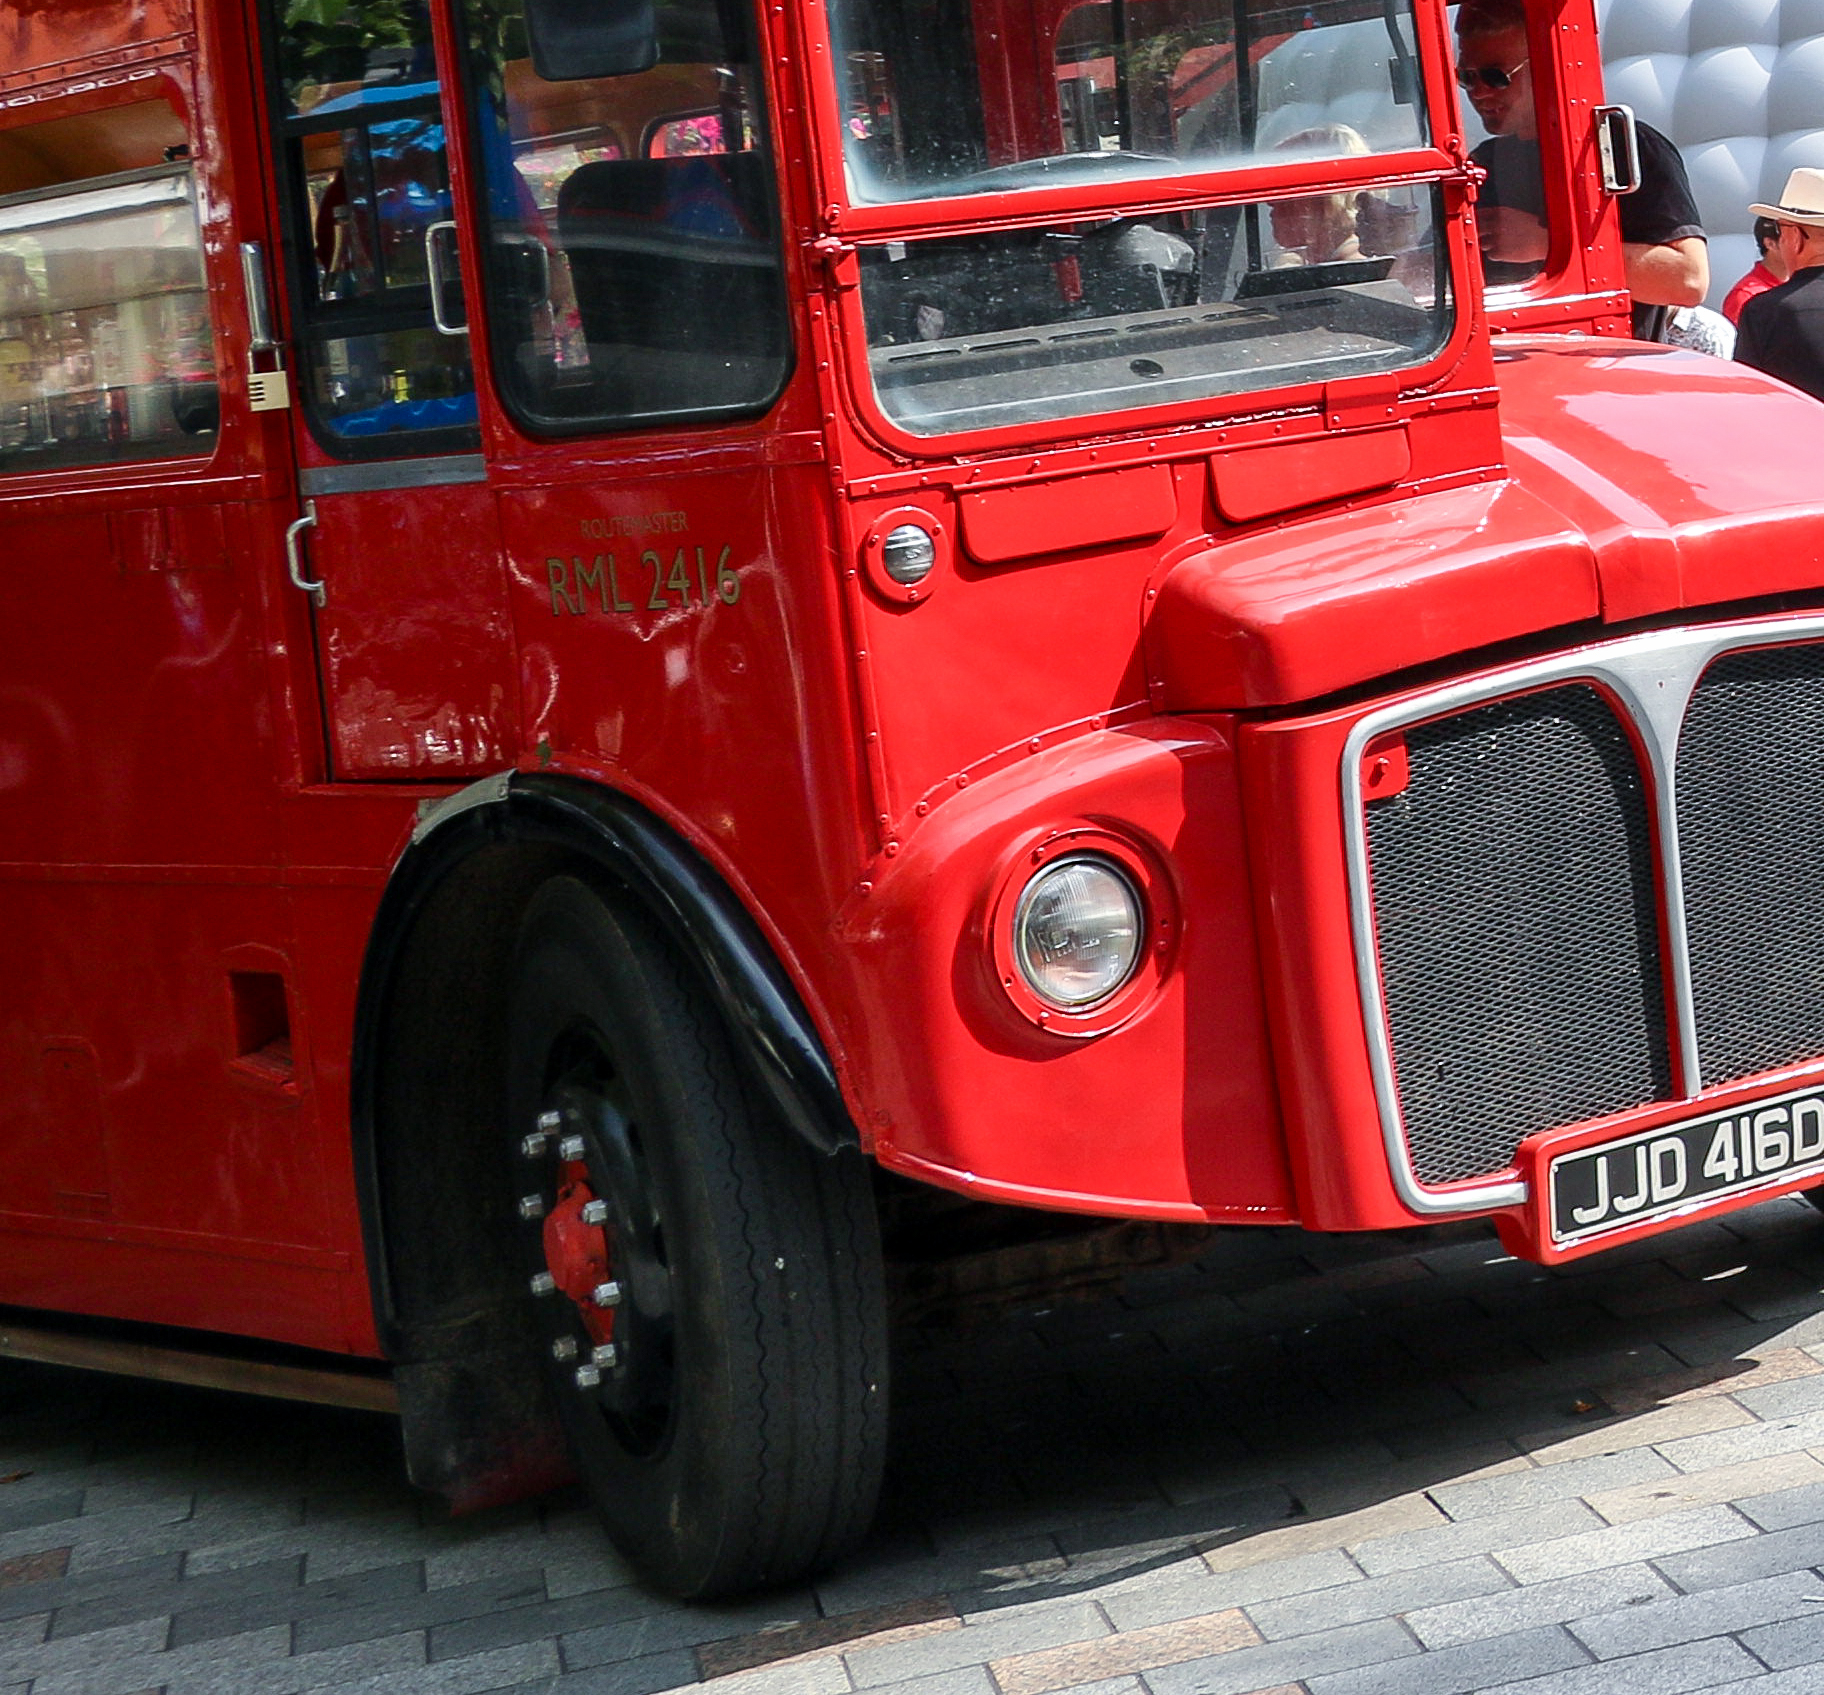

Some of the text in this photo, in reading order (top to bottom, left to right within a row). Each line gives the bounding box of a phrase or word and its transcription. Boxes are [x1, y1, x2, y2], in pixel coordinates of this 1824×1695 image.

[581, 511, 688, 539] ROUTEMASTER
[546, 543, 741, 615] RML 2416
[1573, 1137, 1687, 1224] JJD
